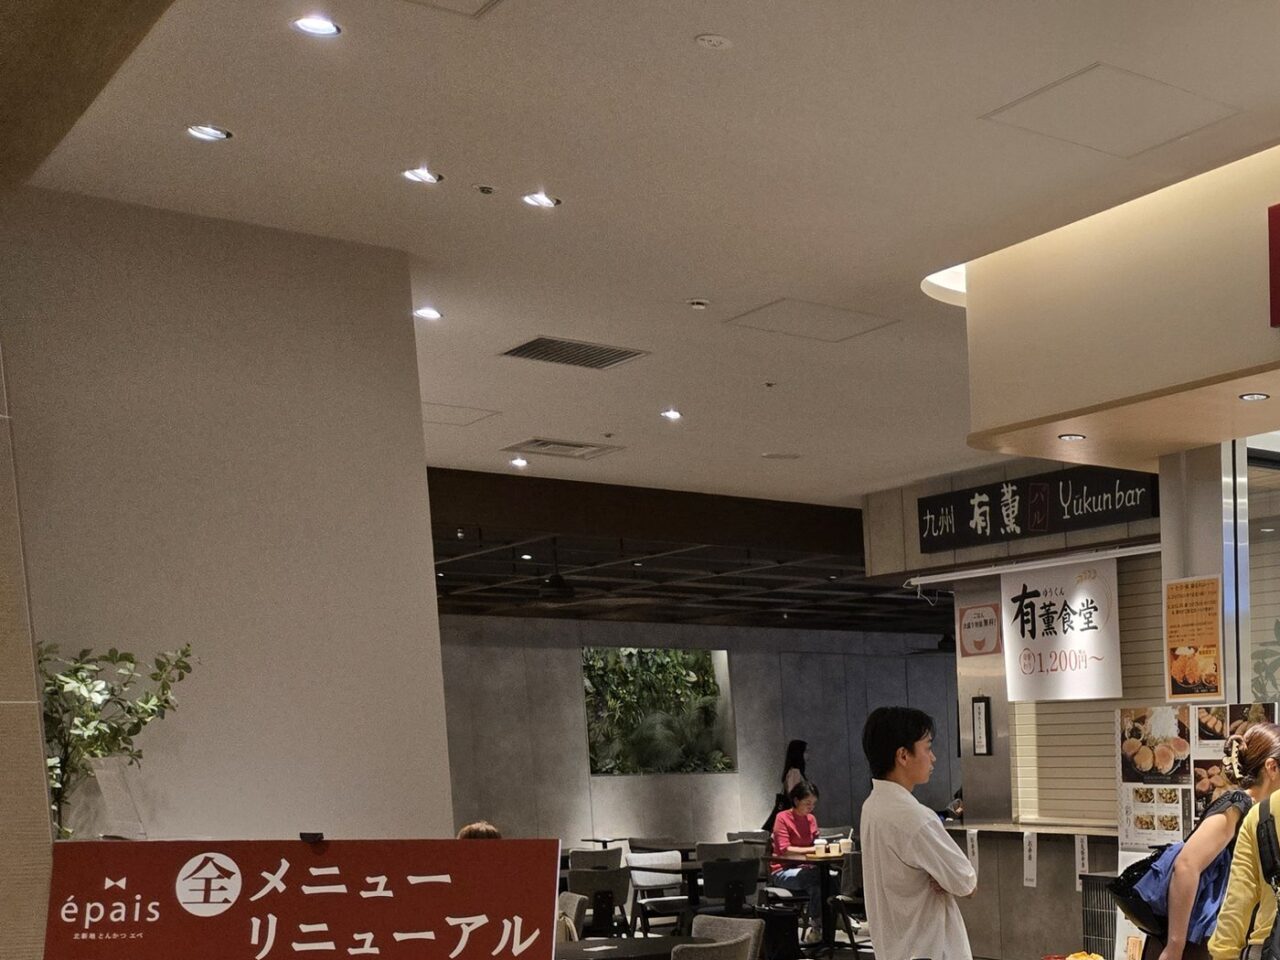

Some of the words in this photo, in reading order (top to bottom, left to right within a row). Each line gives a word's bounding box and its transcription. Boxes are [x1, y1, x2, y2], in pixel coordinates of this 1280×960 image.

[923, 505, 955, 538] 九州
[1011, 583, 1099, 640] 有薫食堂
[60, 895, 161, 929] épais
[250, 913, 541, 960] リニューアル
